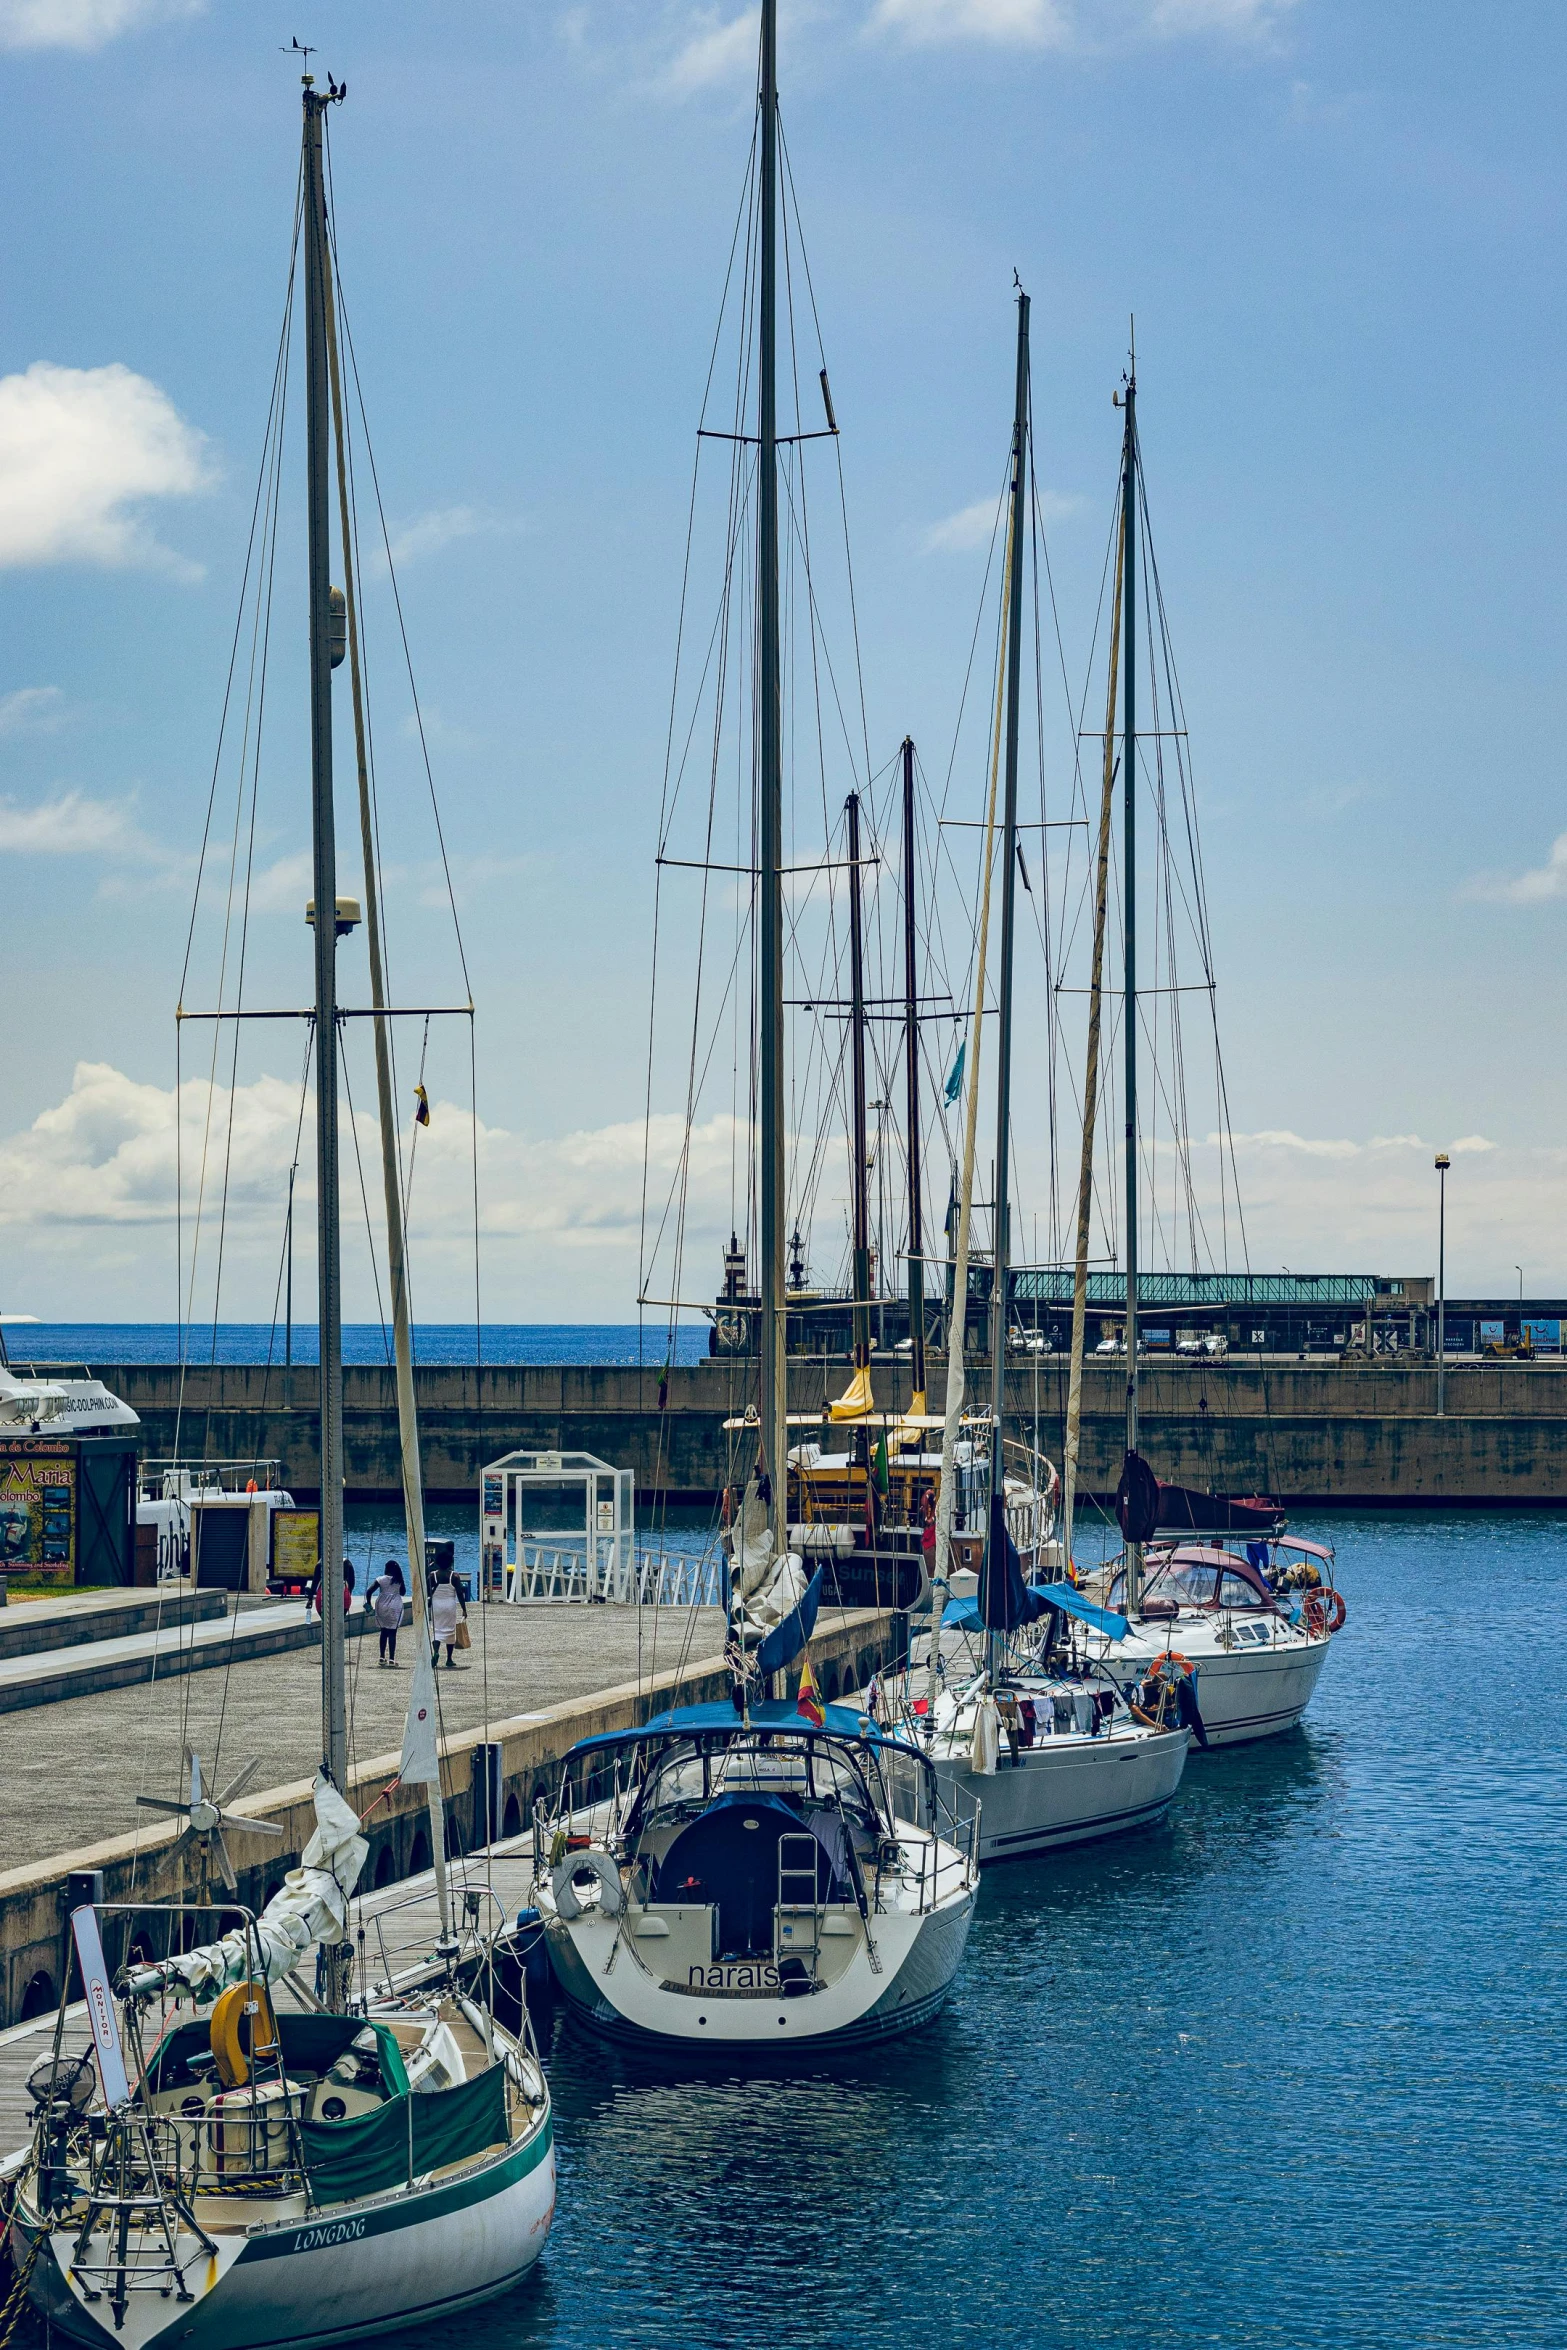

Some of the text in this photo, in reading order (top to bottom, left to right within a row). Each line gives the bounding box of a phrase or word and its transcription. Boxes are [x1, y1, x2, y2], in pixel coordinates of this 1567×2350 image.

[65, 1397, 120, 1413] GIC-DOLPHIN.COM
[9, 1441, 21, 1452] de
[23, 1440, 70, 1453] Colombo
[6, 1462, 73, 1490] Maria
[839, 1565, 905, 1585] Sunset
[92, 1986, 109, 2036] MONITOR
[294, 2218, 366, 2251] LONGDOG
